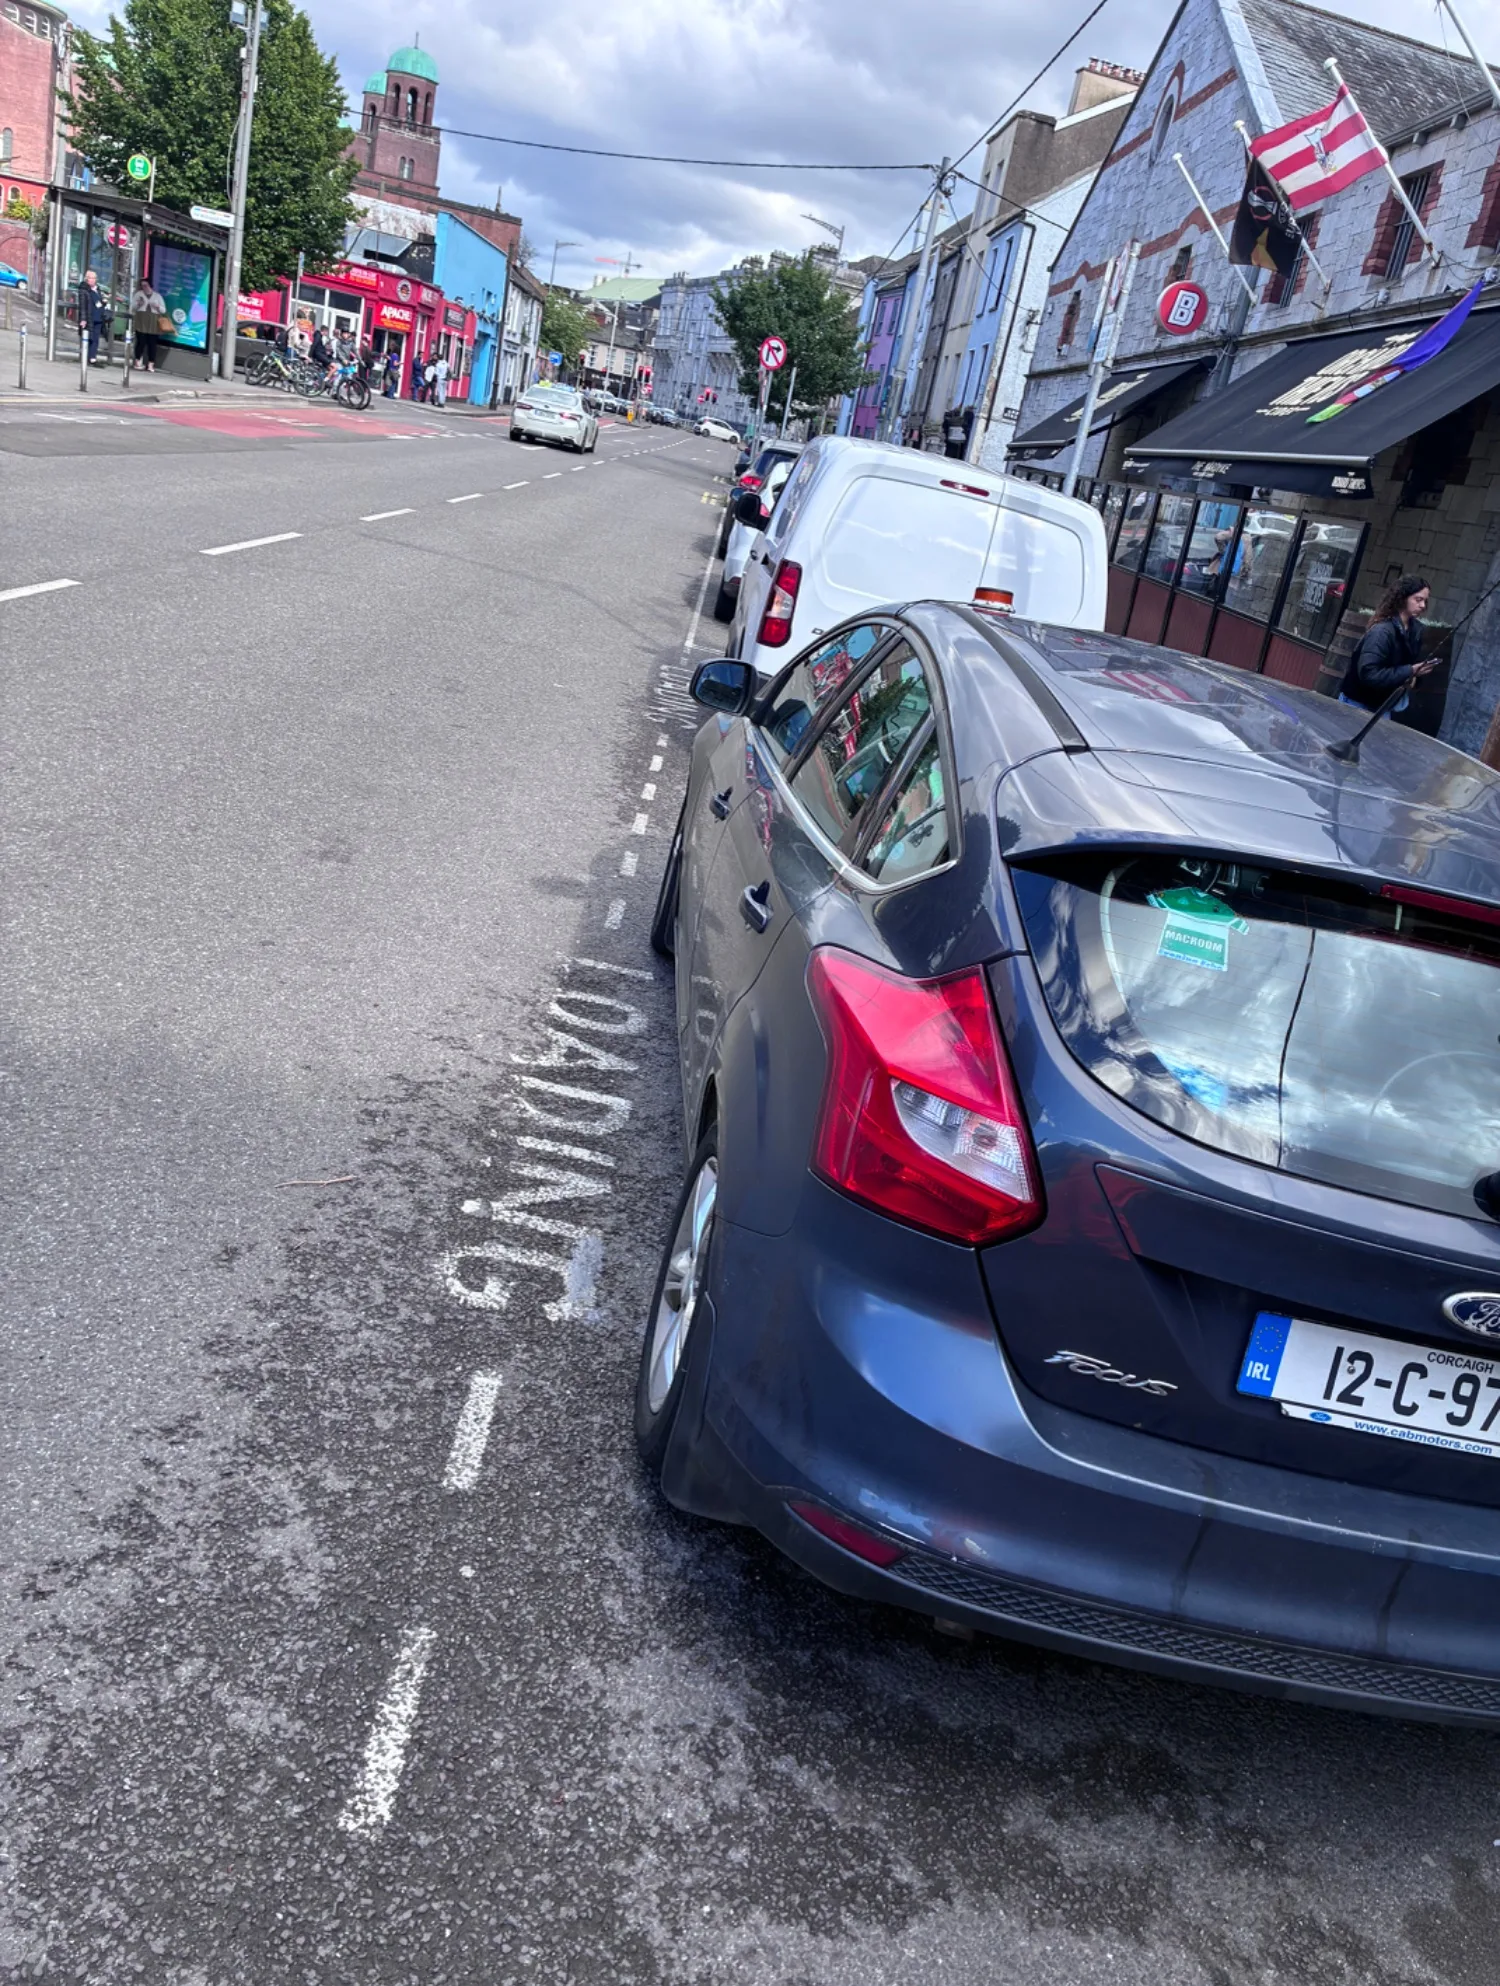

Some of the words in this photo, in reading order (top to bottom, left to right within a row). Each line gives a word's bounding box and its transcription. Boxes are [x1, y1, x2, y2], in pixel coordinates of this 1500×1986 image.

[380, 304, 412, 323] APACHE
[1168, 289, 1199, 327] B
[1165, 930, 1223, 952] MACROOM
[436, 951, 654, 1323] LOADING
[1246, 1361, 1271, 1381] IRL
[1427, 1352, 1495, 1374] CORCAIGH
[1355, 1421, 1492, 1455] www.cabmotors.com
